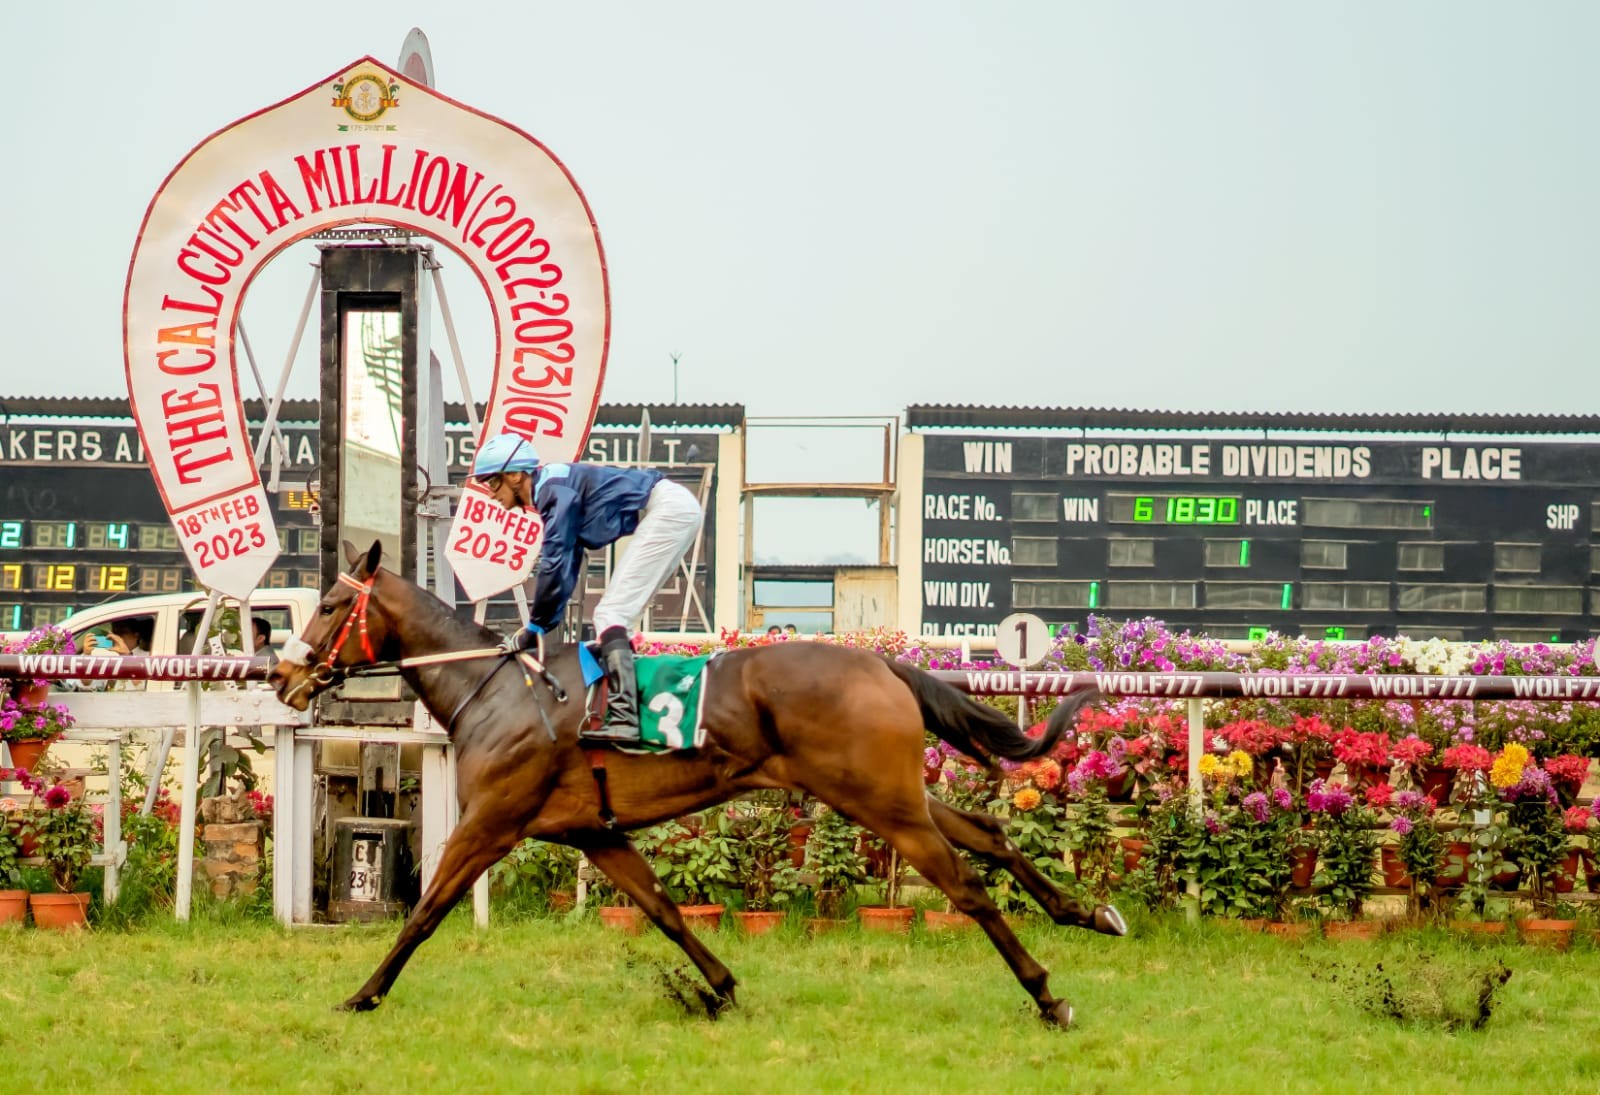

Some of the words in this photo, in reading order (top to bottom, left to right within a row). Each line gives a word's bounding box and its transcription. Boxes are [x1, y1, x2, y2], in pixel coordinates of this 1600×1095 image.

[156, 169, 305, 376] CALCUTTA
[0, 430, 103, 462] KERS
[161, 382, 235, 486] THE
[963, 441, 1013, 473] WIN
[1066, 444, 1211, 477] PROBABLE
[1222, 445, 1372, 479] DIVIDENDS
[1421, 447, 1522, 480] PLACE
[221, 494, 260, 525] FEB
[924, 494, 970, 521] RACE
[974, 495, 1002, 521] No.
[1063, 498, 1098, 522] WIN
[1245, 499, 1297, 525] PLACE
[1546, 504, 1579, 530] SHP
[0, 522, 21, 548] 2
[107, 523, 128, 549] 4
[502, 513, 541, 546] FEB
[193, 522, 266, 569] 2023
[453, 526, 528, 572] 2023
[924, 538, 985, 565] HORSE
[986, 539, 1012, 566] No.
[3, 565, 21, 590] 7
[46, 565, 75, 590] 12
[99, 565, 128, 590] 12
[924, 581, 957, 608] WIN
[960, 582, 995, 608] DIV.
[1013, 620, 1029, 660] 1
[18, 655, 125, 677] WOLF777
[144, 656, 251, 680] WOLF777
[966, 671, 1075, 694] WOLF777
[1095, 673, 1205, 696] WOLF777
[1239, 675, 1349, 698] WOLF777
[1368, 676, 1478, 699] WOLF777
[648, 691, 685, 750] 3
